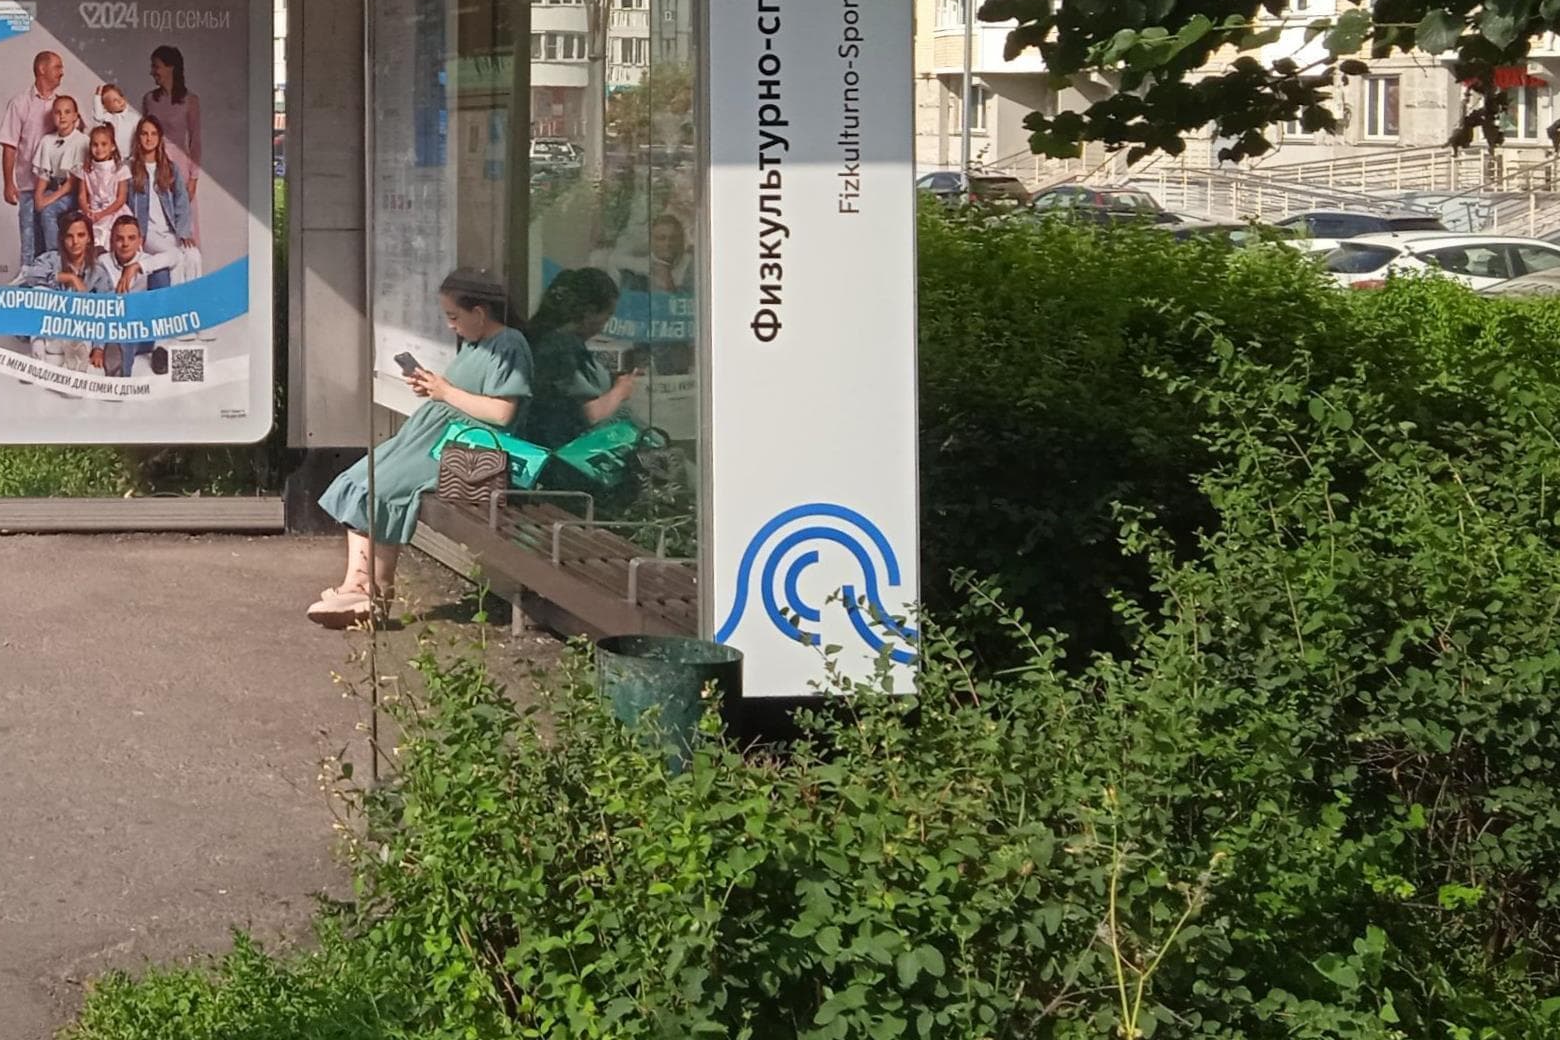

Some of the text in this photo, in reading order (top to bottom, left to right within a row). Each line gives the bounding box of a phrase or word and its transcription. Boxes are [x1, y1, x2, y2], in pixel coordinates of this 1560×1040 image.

[89, 1, 139, 29] 2024
[69, 295, 126, 319] ЛЮДЕЙ
[39, 311, 201, 340] ДОЛЖНО БЫТЬ МНОГО
[6, 357, 28, 373] МЕРЫ
[27, 364, 72, 387] ПОДДЕРЖКИ
[71, 377, 88, 390] ДЛЯ
[88, 380, 113, 394] СЕМЕЙ
[119, 384, 151, 396] ДЕТЬМИ
